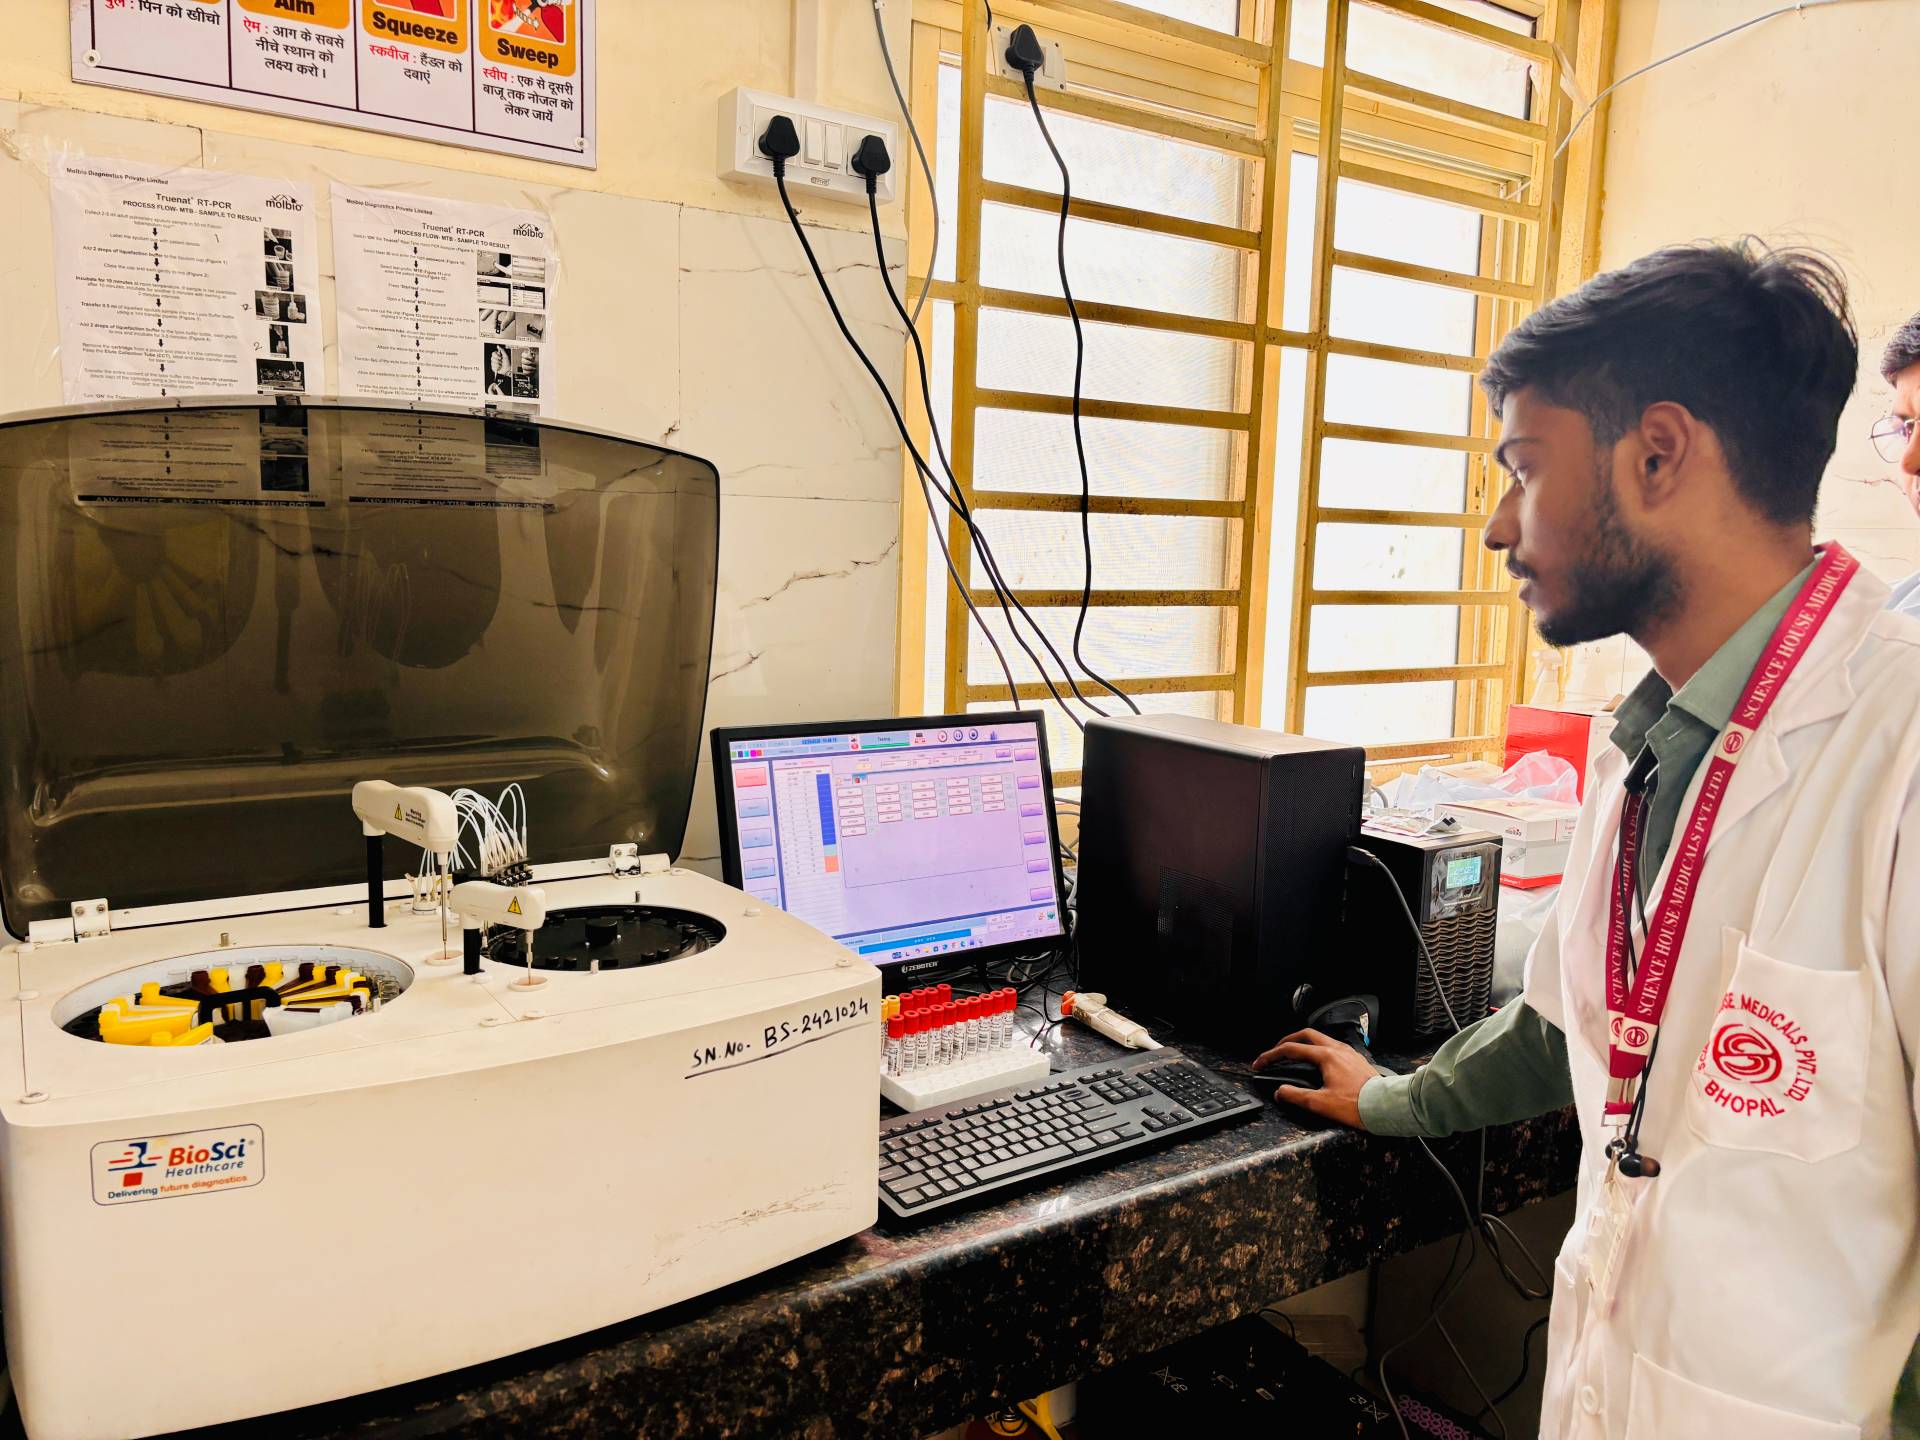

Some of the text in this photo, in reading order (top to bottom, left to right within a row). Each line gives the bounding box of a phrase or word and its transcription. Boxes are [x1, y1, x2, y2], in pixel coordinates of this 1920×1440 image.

[166, 3, 182, 18] को
[274, 0, 315, 15] Aim
[273, 25, 296, 39] आग
[300, 28, 312, 42] के
[315, 33, 344, 48] सबसे
[372, 11, 458, 45] Squeeze
[256, 36, 334, 63] नीचे स्थान को
[497, 38, 559, 69] Sweep
[264, 57, 293, 72] लक्ष्य
[403, 68, 431, 84] दबाएं
[448, 59, 463, 73] को
[483, 66, 508, 82] स्वीप
[517, 75, 534, 87] एक
[536, 76, 546, 90] से
[548, 80, 574, 96] दूसरी
[482, 83, 574, 111] बाजू तक नोजल को
[504, 101, 530, 118] लेकर
[122, 200, 156, 210] PROCESS
[198, 209, 226, 218] SAMPLE
[237, 214, 262, 223] RESULT
[197, 199, 232, 209] RT-PCR
[265, 198, 302, 212] molbio
[393, 229, 421, 238] PROCESS
[457, 237, 480, 246] SAMPLE
[488, 241, 510, 250] RESULT
[456, 227, 485, 238] RT-PCR
[513, 227, 544, 239] molbio
[1742, 650, 1785, 721] SCIENCE
[1777, 604, 1815, 661] HOUSE
[1636, 769, 1727, 1016] SCIENCE HOUSE MEDICALS PVT. LTD.
[1612, 903, 1626, 950] HOUSE
[1612, 950, 1626, 1007] SCIENCE
[764, 997, 869, 1049] BS-2421024
[1740, 993, 1808, 1046] MEDICALS
[1704, 1079, 1786, 1118] BHOPAL
[168, 1138, 246, 1167] BioSci
[165, 1160, 244, 1179] Healthcare
[108, 1174, 248, 1200] Delivering future diagnostics
